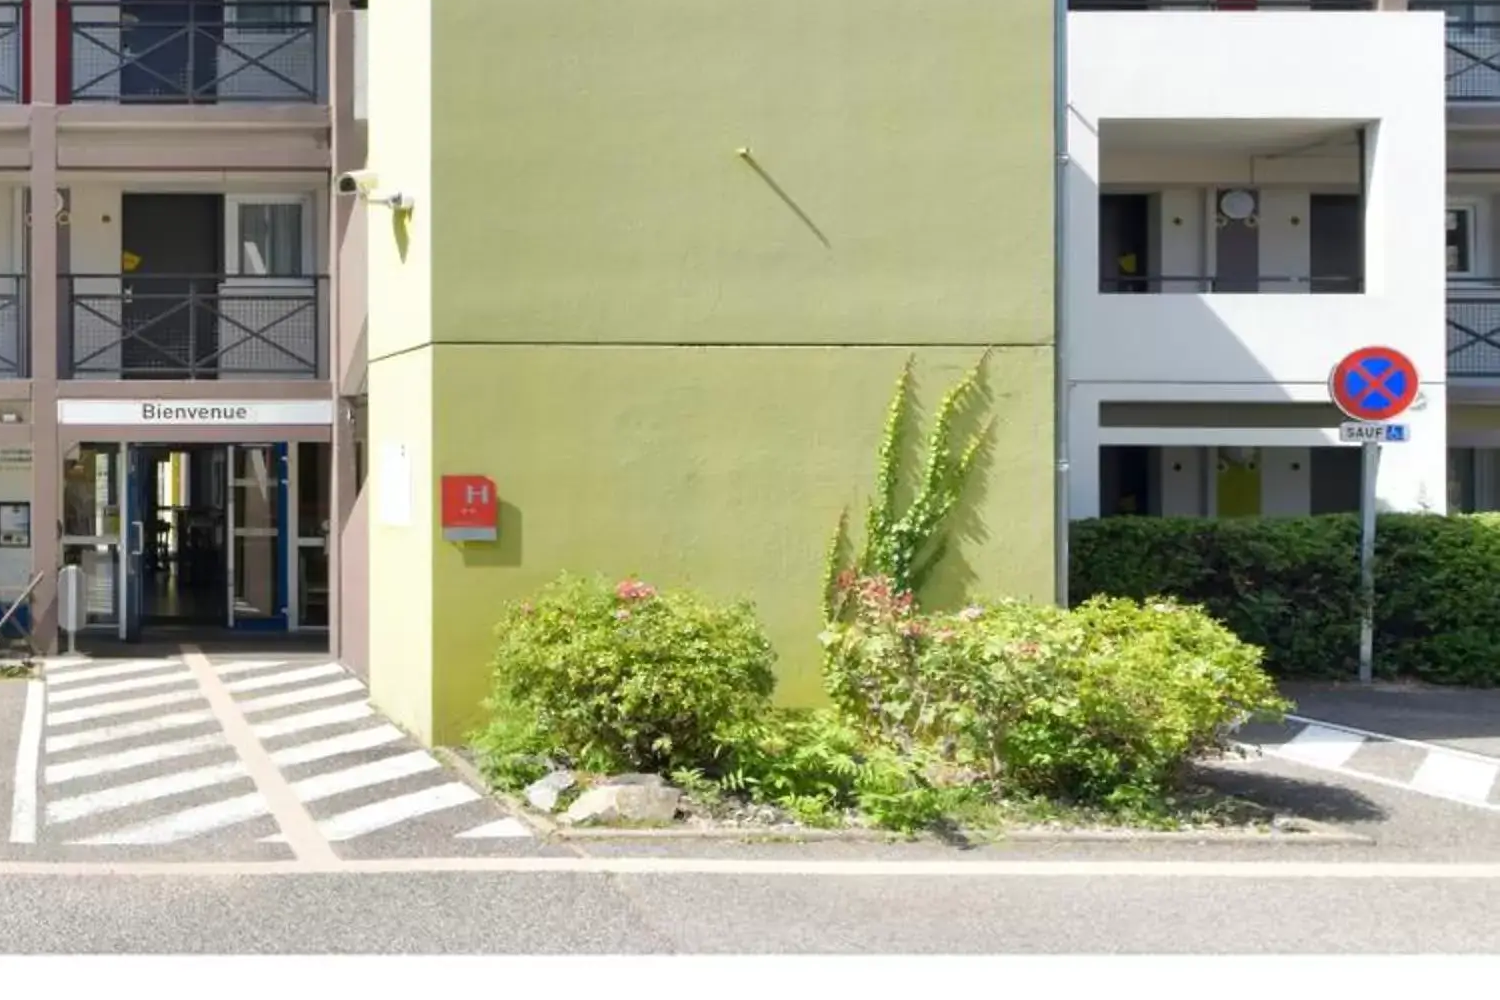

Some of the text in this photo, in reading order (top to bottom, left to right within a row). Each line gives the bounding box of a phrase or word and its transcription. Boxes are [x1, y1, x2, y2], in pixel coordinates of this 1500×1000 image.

[142, 403, 247, 419] Bienvenue
[1347, 426, 1383, 438] SAUF
[466, 484, 490, 504] H
